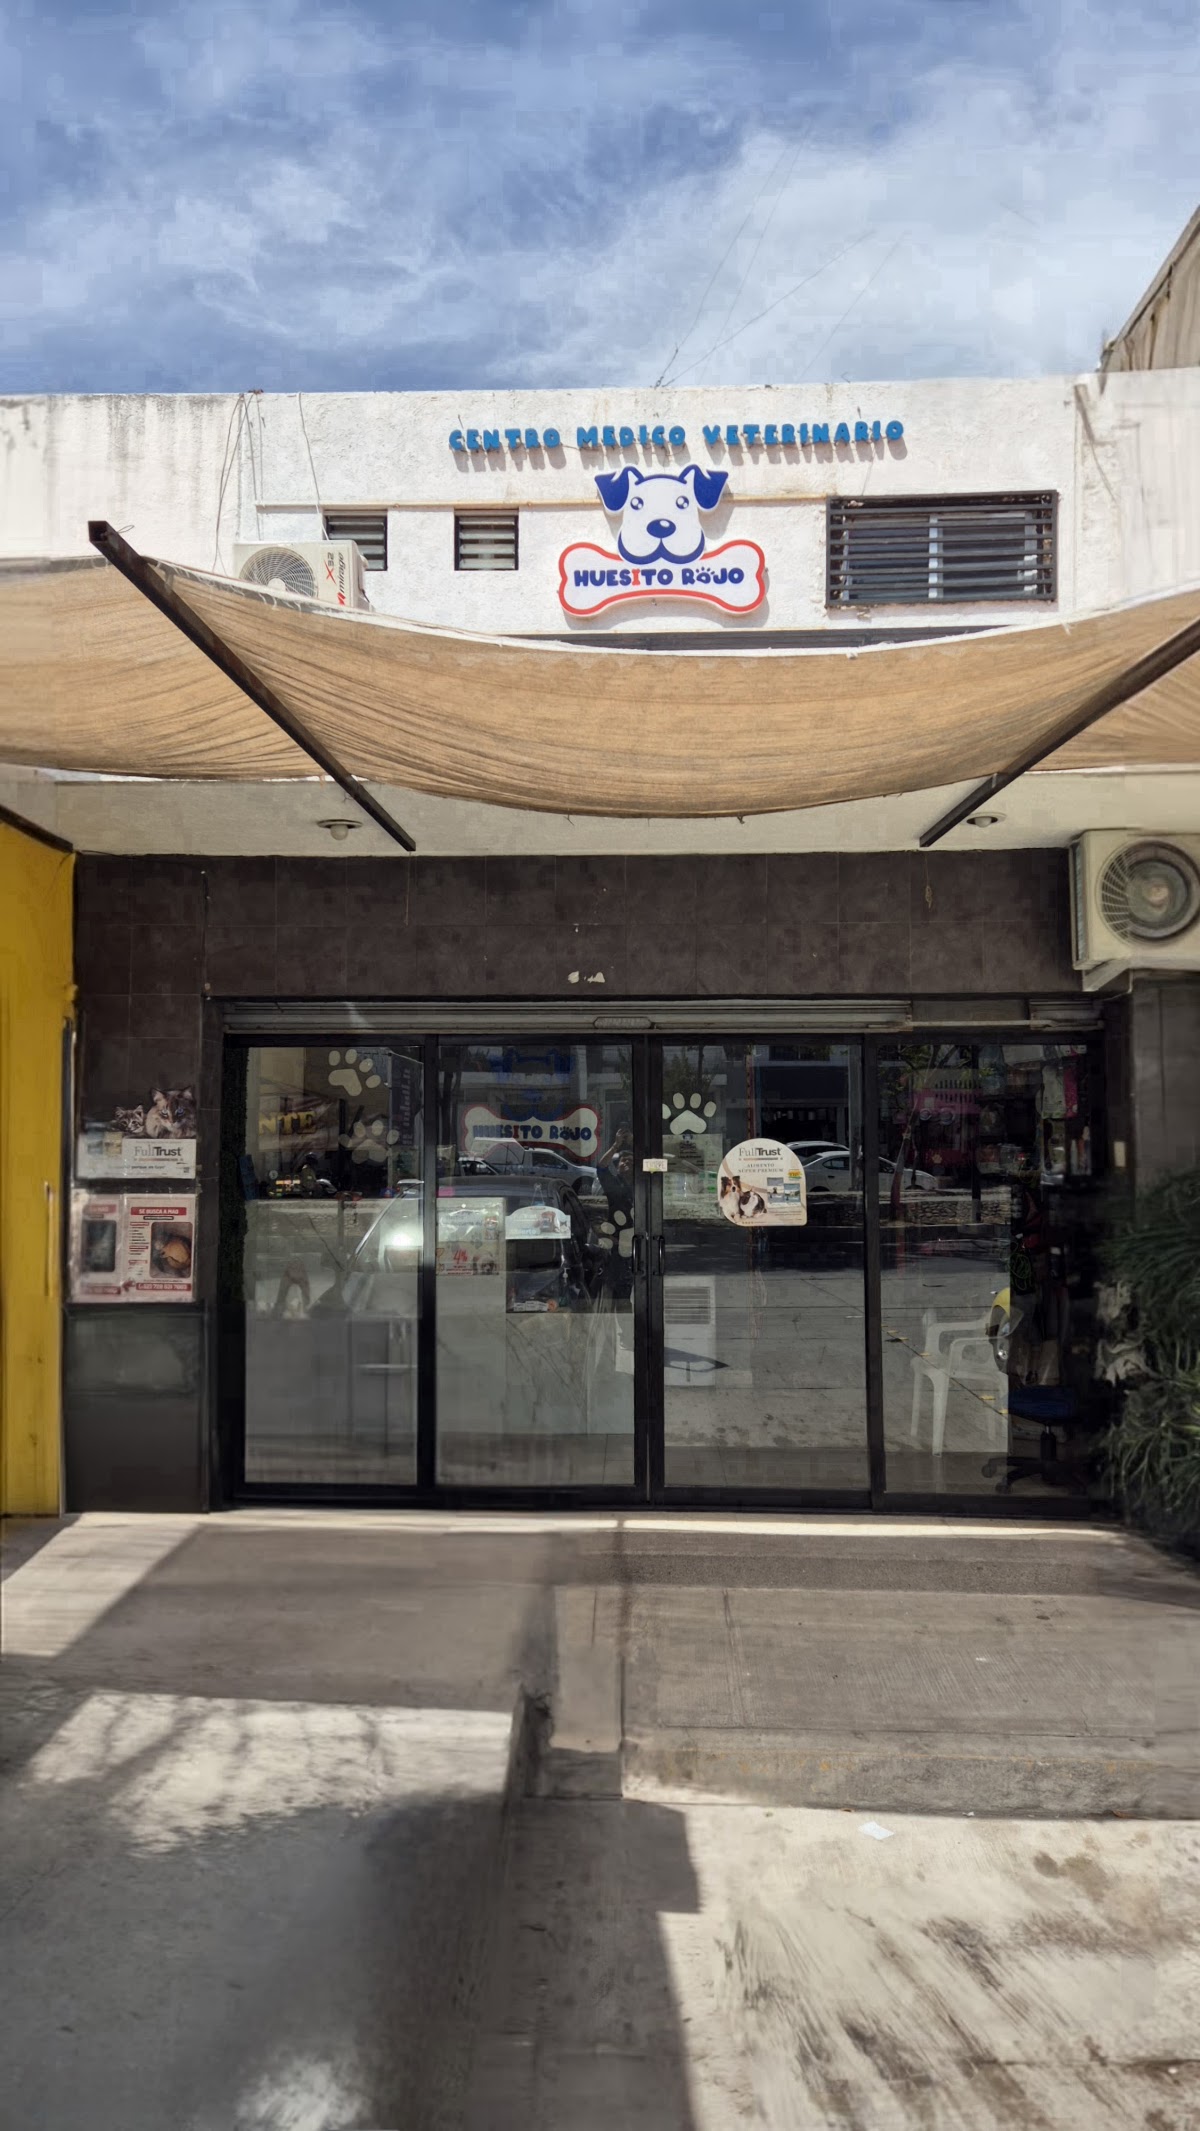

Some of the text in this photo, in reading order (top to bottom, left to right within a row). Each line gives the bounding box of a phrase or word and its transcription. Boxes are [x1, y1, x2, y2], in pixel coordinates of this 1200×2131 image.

[449, 420, 904, 450] CENTRO MEDICO VETERINARIO
[338, 552, 347, 594] mirage
[573, 568, 674, 587] HUESITO
[134, 1145, 182, 1157] FullTrust
[739, 1147, 782, 1157] FullTrust
